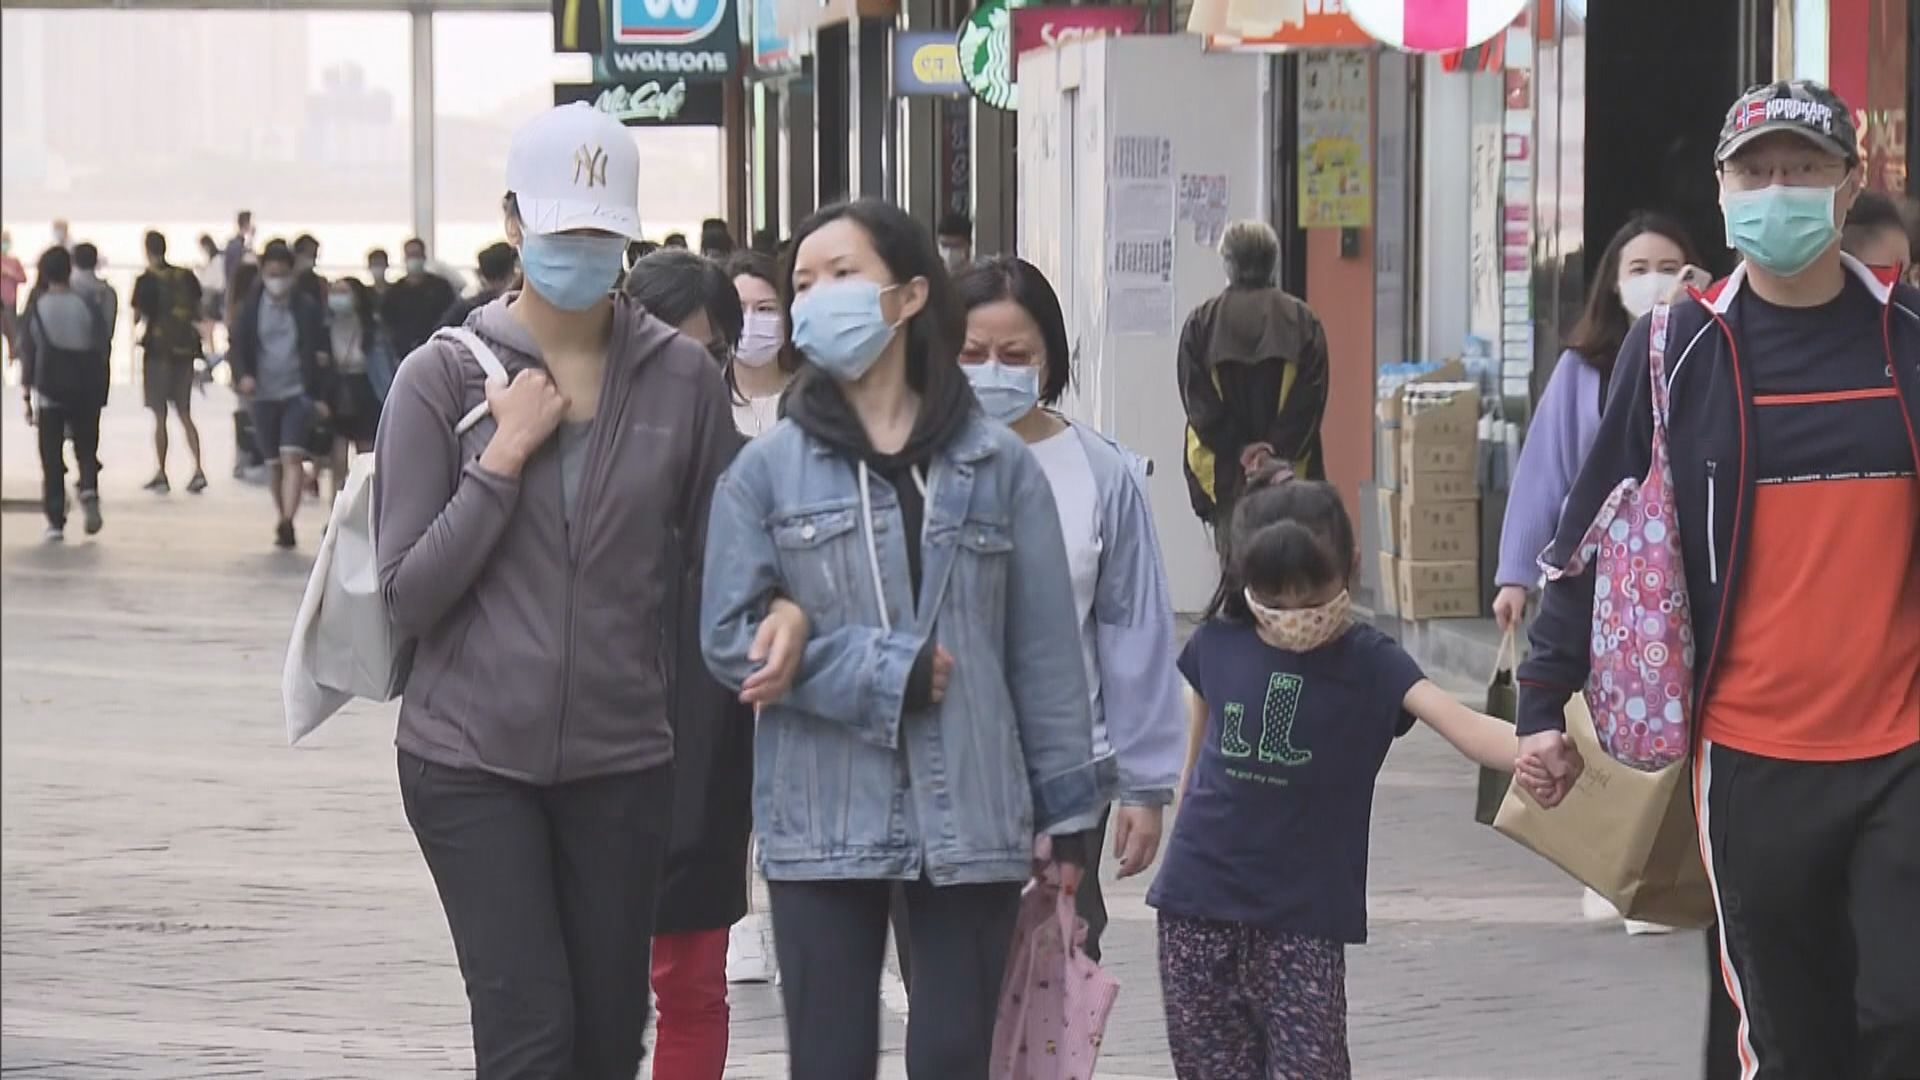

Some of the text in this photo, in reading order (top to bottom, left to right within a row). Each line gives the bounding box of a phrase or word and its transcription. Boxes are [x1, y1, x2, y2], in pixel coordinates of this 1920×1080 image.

[613, 50, 728, 73] watsons
[1765, 98, 1833, 135] NORDKAPP
[573, 143, 609, 189] NY
